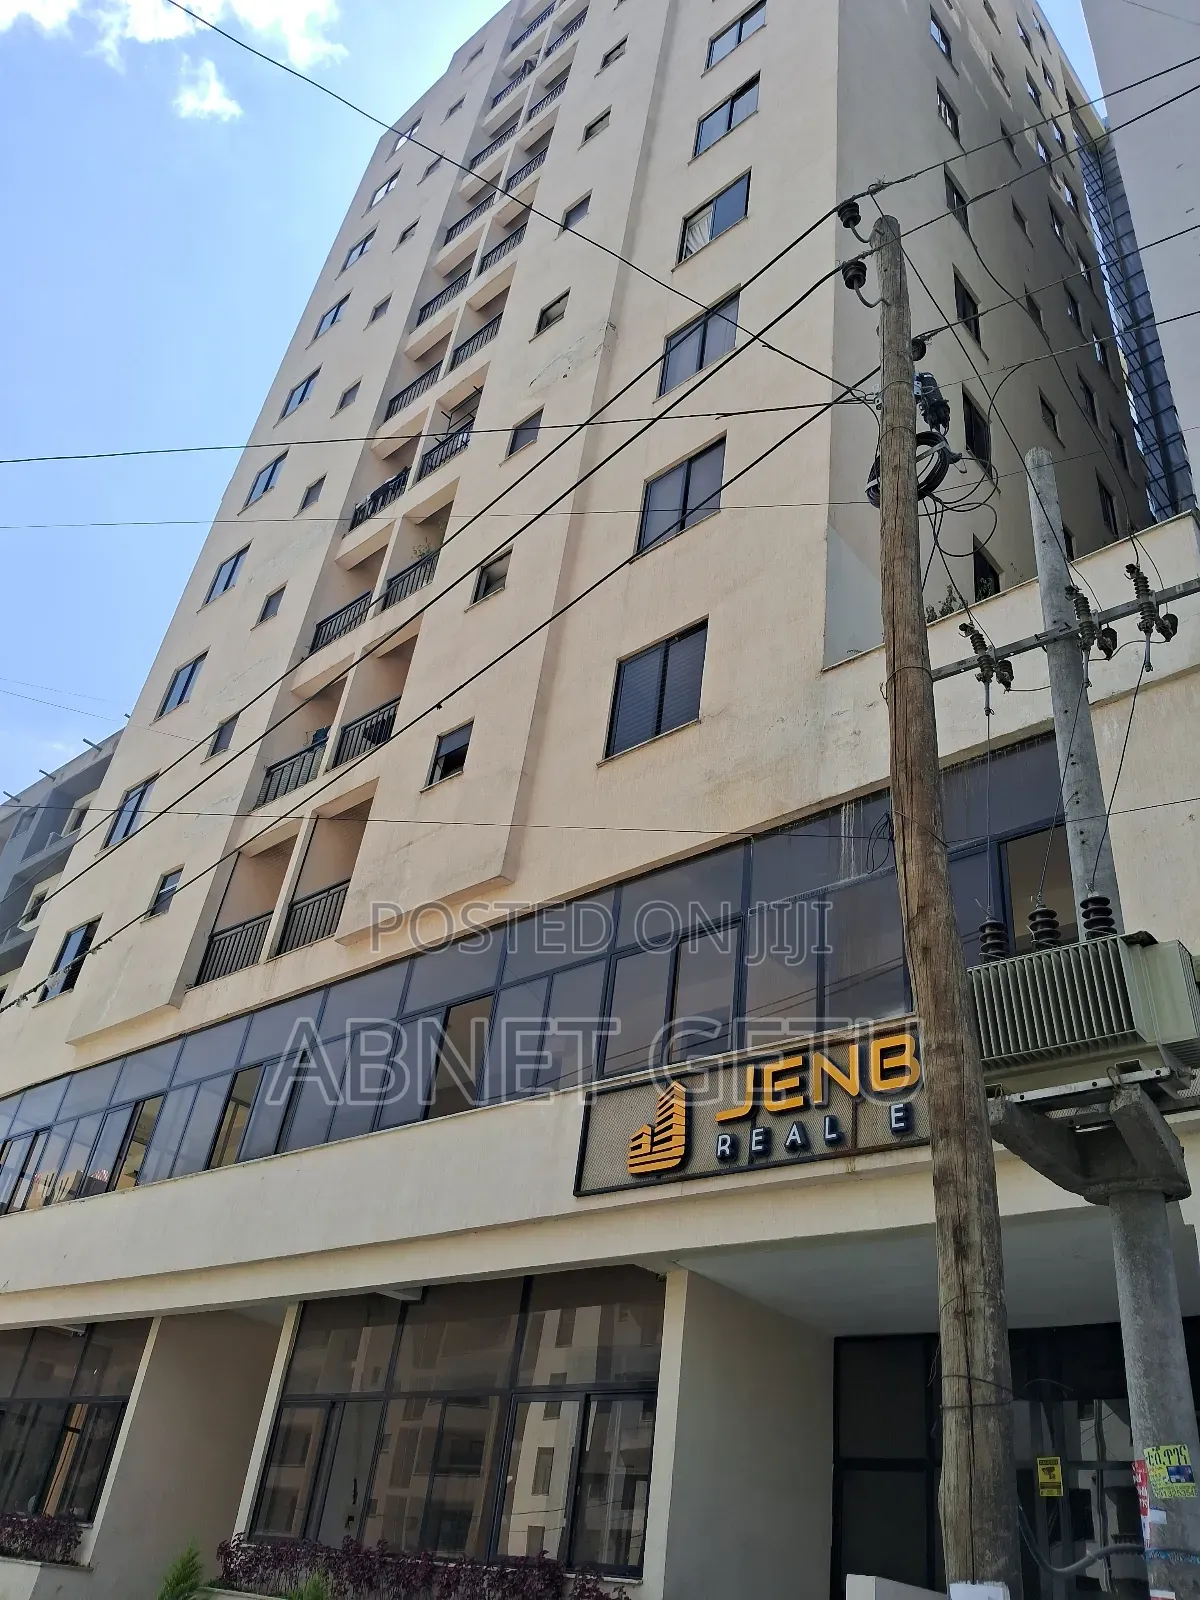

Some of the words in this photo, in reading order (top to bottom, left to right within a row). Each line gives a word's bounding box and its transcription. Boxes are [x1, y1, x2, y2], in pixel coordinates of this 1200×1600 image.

[714, 1033, 922, 1126] JENB
[716, 1115, 841, 1160] REAL
[889, 1103, 911, 1133] E
